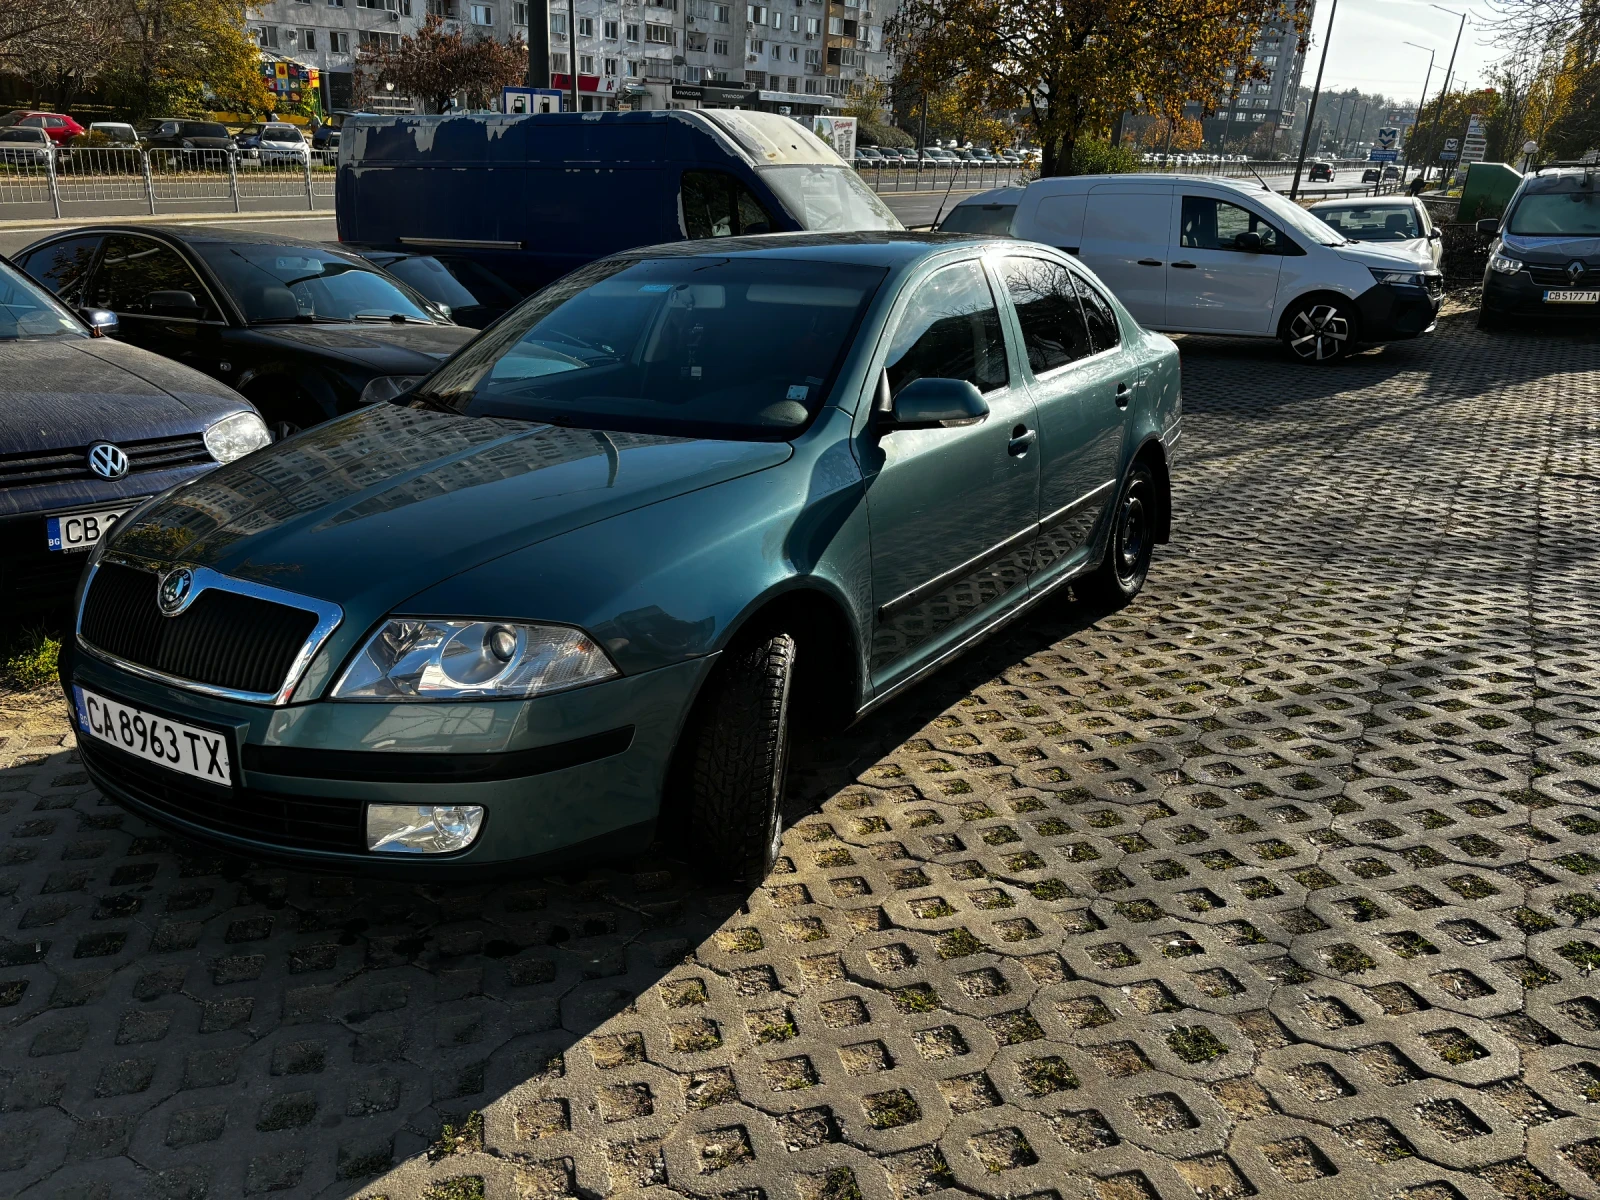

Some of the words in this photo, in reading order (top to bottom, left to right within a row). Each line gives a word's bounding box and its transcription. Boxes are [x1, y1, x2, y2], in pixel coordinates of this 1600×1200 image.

[606, 80, 615, 91] A1
[1549, 292, 1560, 300] CB
[1562, 292, 1585, 301] 5177
[1586, 292, 1597, 301] TA
[66, 516, 101, 543] CB
[48, 538, 60, 547] BG
[80, 713, 89, 726] BG
[86, 696, 118, 742] CA
[119, 709, 181, 763] 8963
[183, 730, 225, 778] TX
